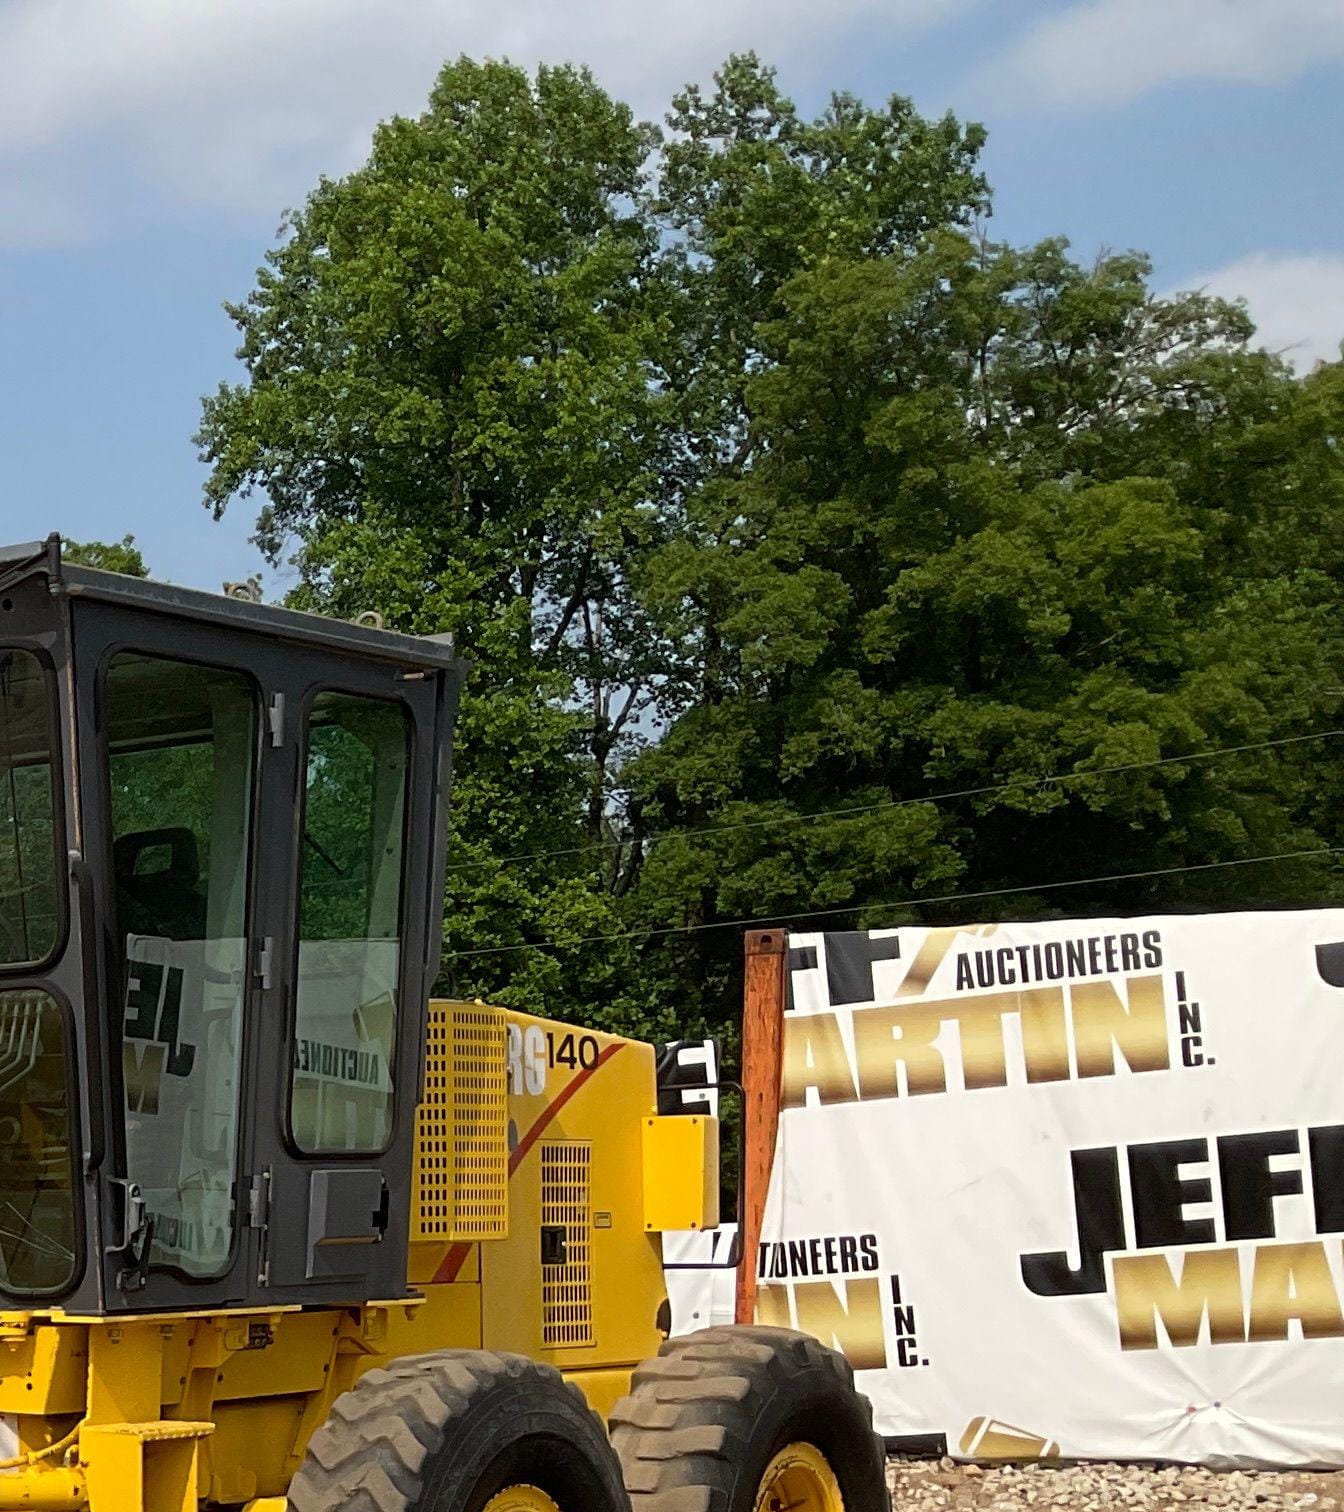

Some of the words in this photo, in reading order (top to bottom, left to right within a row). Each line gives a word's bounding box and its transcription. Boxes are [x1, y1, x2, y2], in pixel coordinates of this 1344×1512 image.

[956, 930, 1164, 991] AUCTIONEERS
[546, 1032, 600, 1070] 140
[1176, 970, 1217, 1068] INC.
[891, 1274, 929, 1368] INC.
